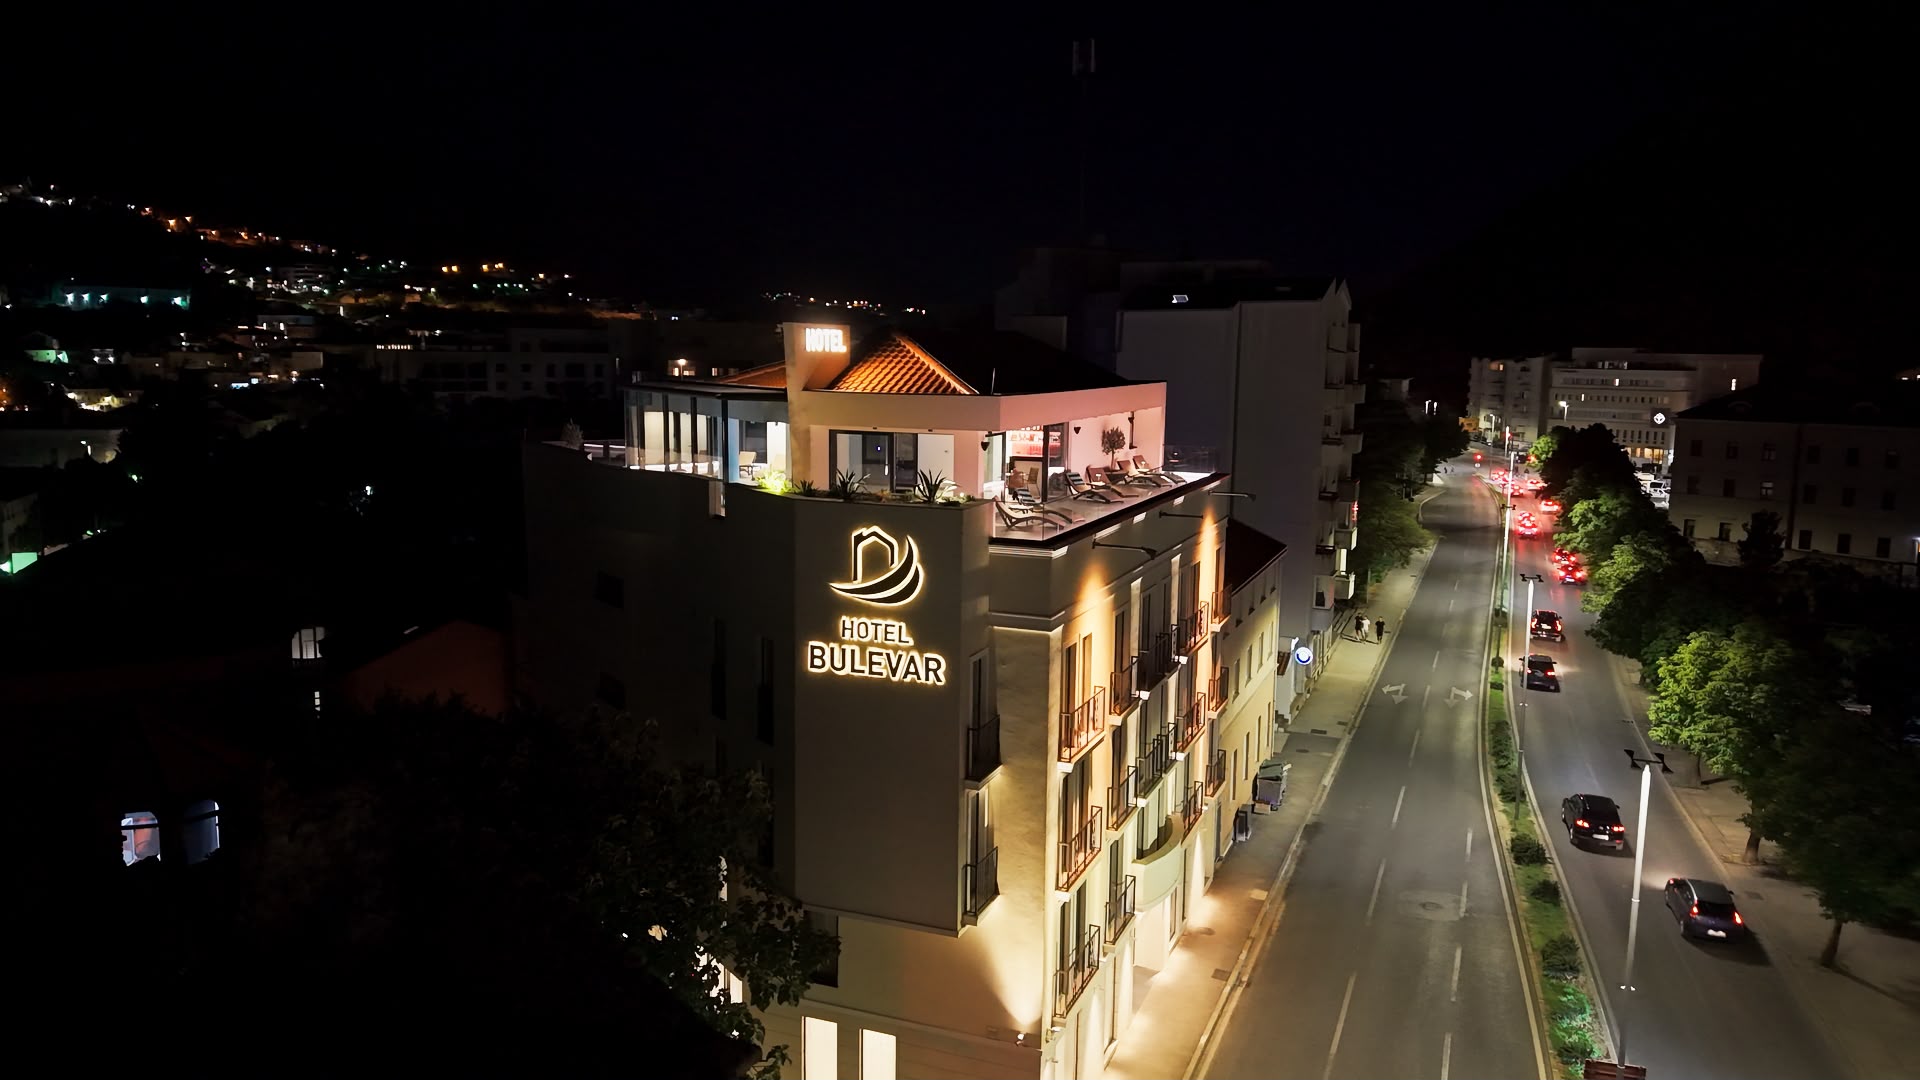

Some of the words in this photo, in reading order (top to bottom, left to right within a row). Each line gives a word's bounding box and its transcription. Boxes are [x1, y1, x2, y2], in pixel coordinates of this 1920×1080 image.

[805, 327, 847, 352] HOTEL
[840, 617, 912, 645] HOTEL
[808, 642, 945, 685] BULEVAR
